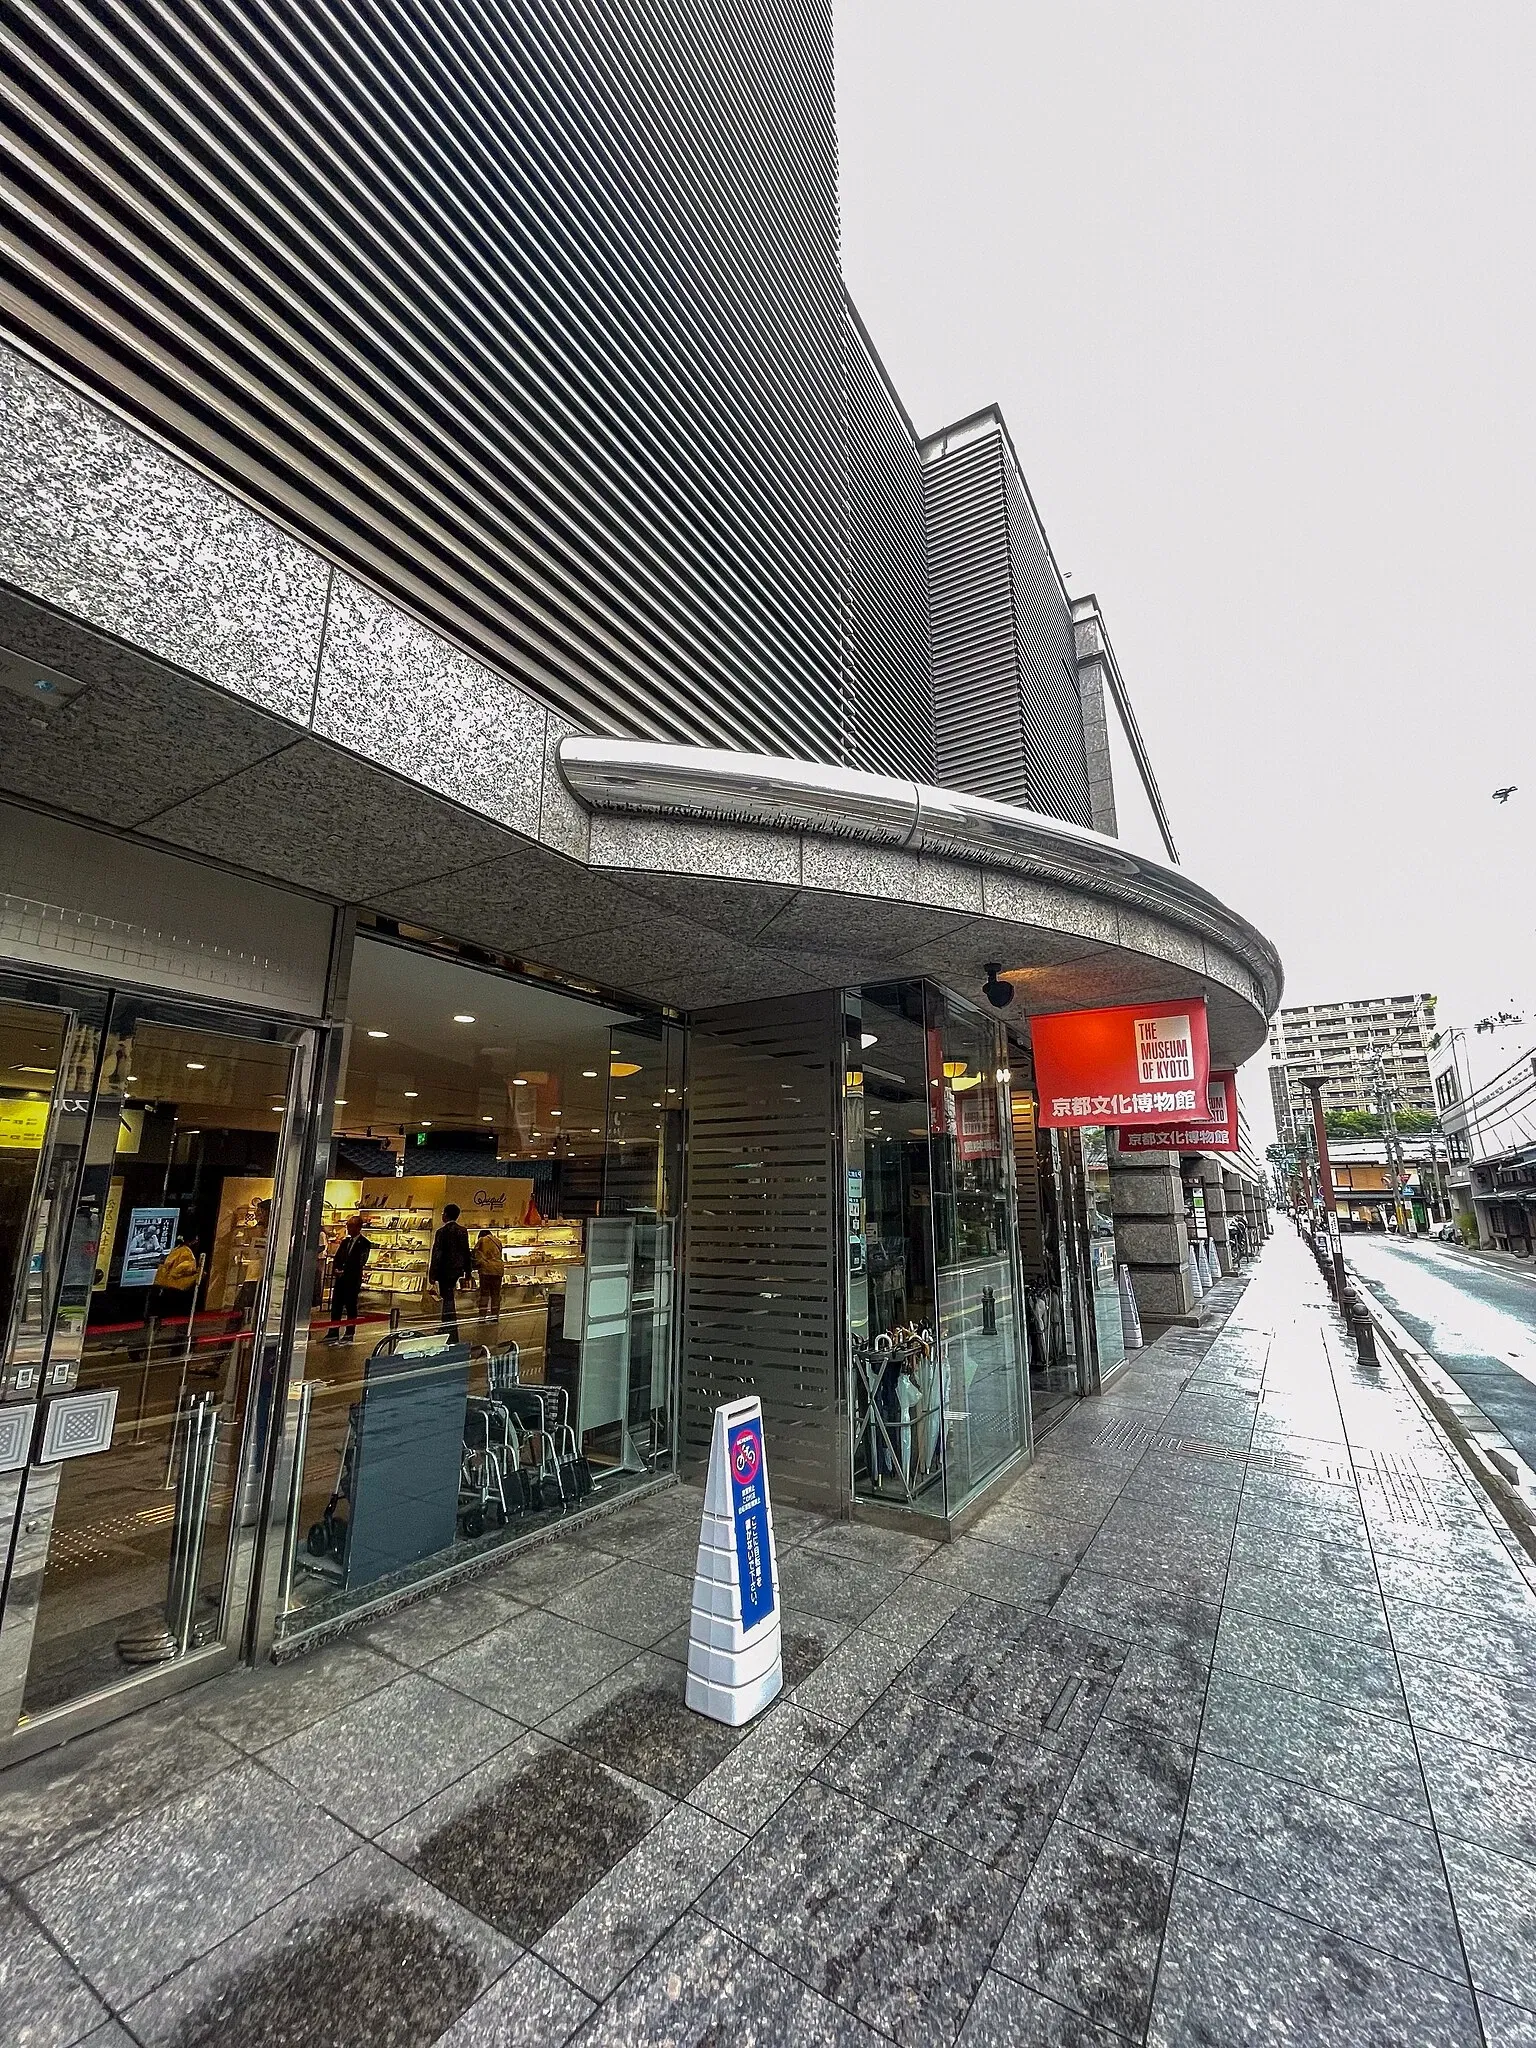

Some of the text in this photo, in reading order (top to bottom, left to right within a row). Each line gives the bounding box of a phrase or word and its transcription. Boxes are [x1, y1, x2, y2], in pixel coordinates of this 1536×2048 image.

[1138, 1022, 1157, 1040] THE
[1141, 1039, 1188, 1060] MUSEUM
[1142, 1059, 1189, 1079] OF KYOTO
[1051, 1090, 1196, 1117] 京都文化博物館
[1128, 1130, 1230, 1146] 京都文化博物館
[751, 1515, 763, 1588] ここに自転車を
